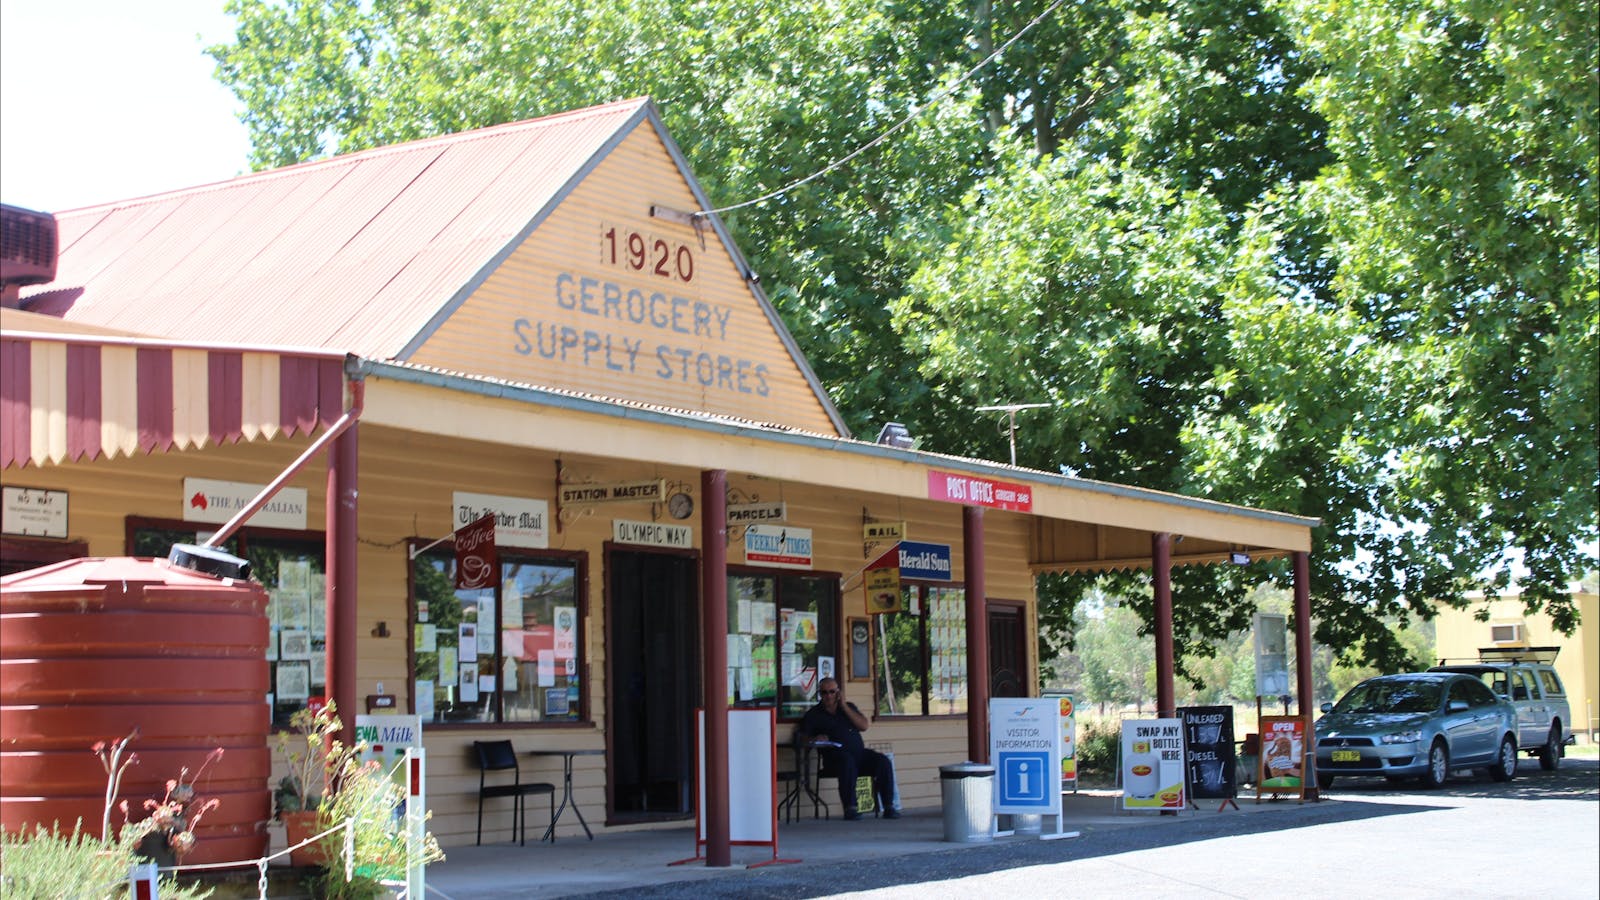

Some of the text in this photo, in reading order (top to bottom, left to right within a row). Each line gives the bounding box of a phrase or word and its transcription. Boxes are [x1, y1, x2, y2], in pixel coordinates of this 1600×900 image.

[605, 227, 694, 282] 1920
[556, 272, 732, 340] GEROGERY
[514, 318, 770, 397] SUPPLY STORES
[563, 485, 659, 500] STATION MASTER
[946, 477, 967, 499] POST
[969, 480, 994, 503] OFFICE
[208, 496, 231, 508] THE
[519, 512, 542, 530] Mail
[729, 508, 782, 521] PARCELS
[619, 523, 687, 546] OLYMPIC WAY
[869, 527, 898, 536] MAIL
[455, 528, 494, 552] Coffee
[747, 533, 811, 556] WEEKLY TIMES
[898, 549, 950, 571] Herald Sun
[1186, 713, 1225, 724] UNLEADED
[355, 726, 414, 743] EWA Milk
[1006, 728, 1040, 737] VISITOR
[1136, 726, 1180, 737] SWAP ANY
[1272, 722, 1295, 732] OPEN
[995, 740, 1052, 749] INFORMATION
[1153, 739, 1180, 749] BOTTLE
[1161, 750, 1180, 761] HERE
